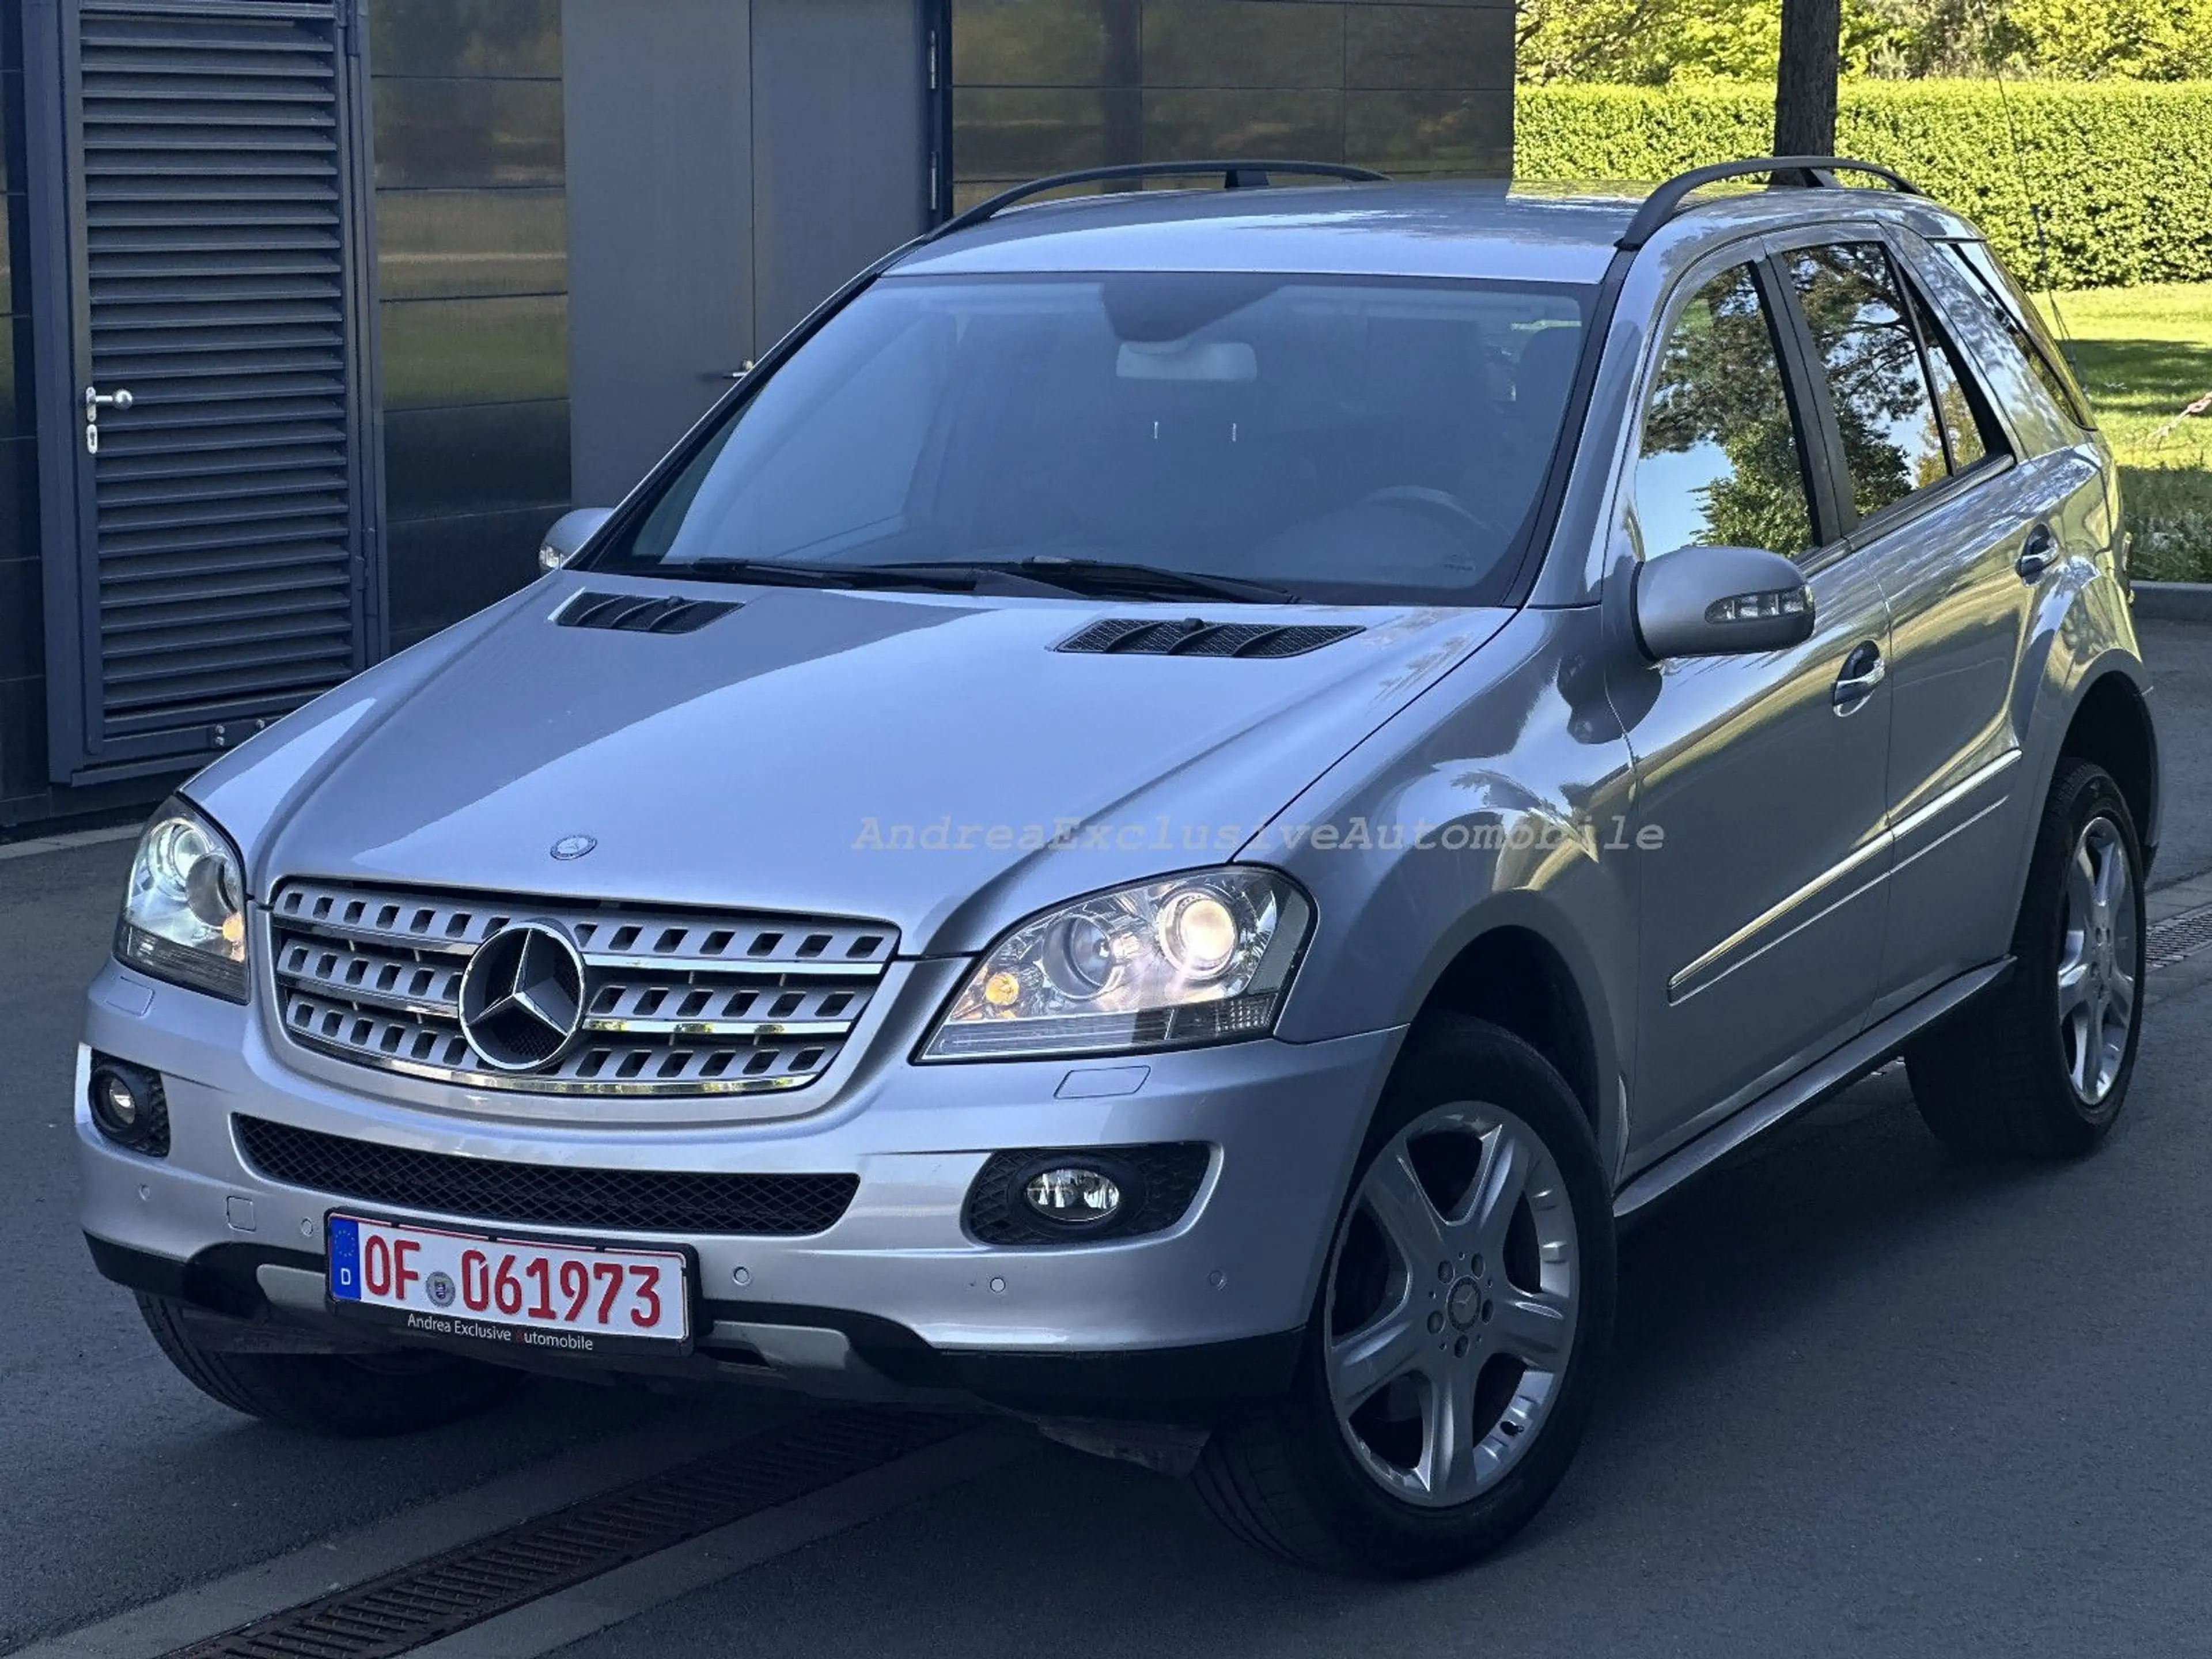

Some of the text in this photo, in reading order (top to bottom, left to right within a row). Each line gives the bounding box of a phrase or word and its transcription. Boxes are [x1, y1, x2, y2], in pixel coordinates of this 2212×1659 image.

[340, 1267, 351, 1286] D
[365, 1234, 661, 1328] OF 061973
[407, 1313, 451, 1333] Andrea
[454, 1320, 512, 1341] Exclusive
